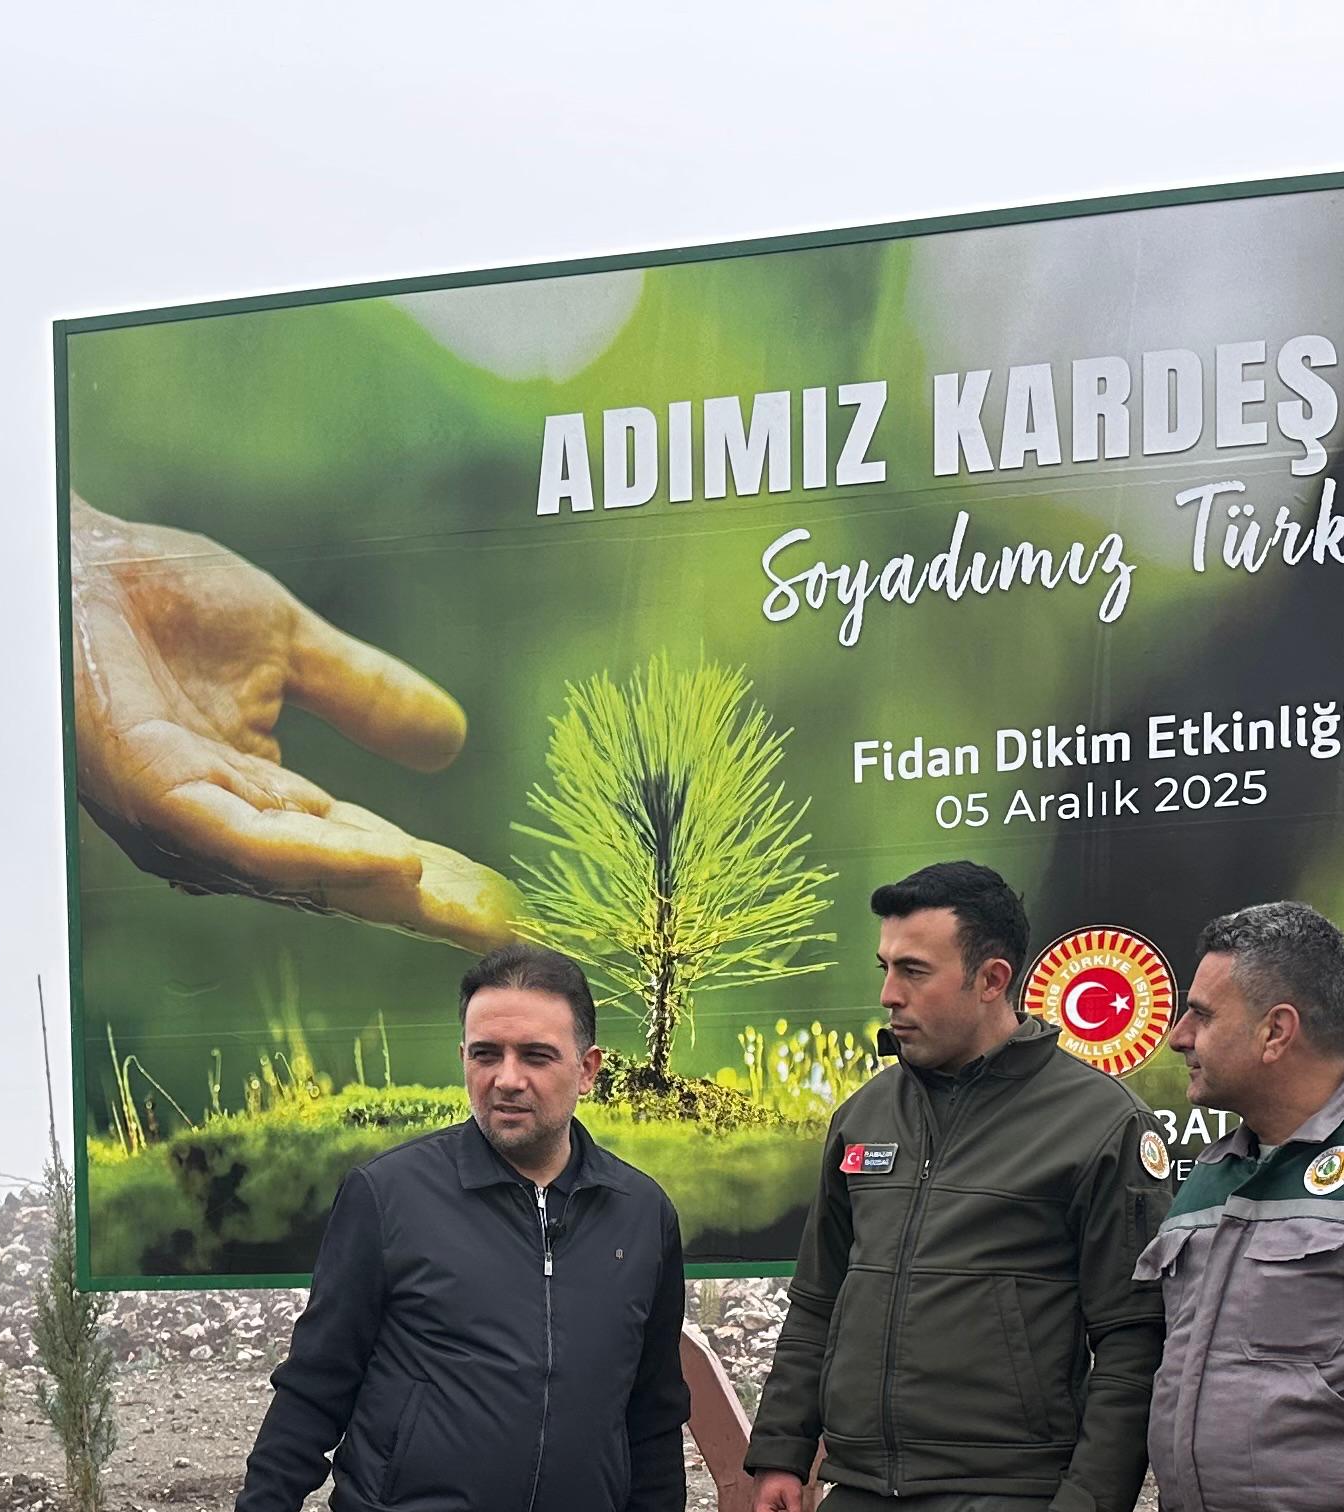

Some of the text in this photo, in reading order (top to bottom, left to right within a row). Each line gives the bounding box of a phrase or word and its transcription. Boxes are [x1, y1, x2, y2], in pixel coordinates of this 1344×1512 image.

[536, 380, 888, 516] ADIMIZ
[761, 510, 1137, 647] Soyadımız
[854, 736, 979, 784] Fidan
[996, 724, 1131, 772] Dikim
[935, 769, 1267, 829] 05 Aralık 2025
[1047, 984, 1061, 1027] BÜY
[1153, 1107, 1244, 1145] BAT
